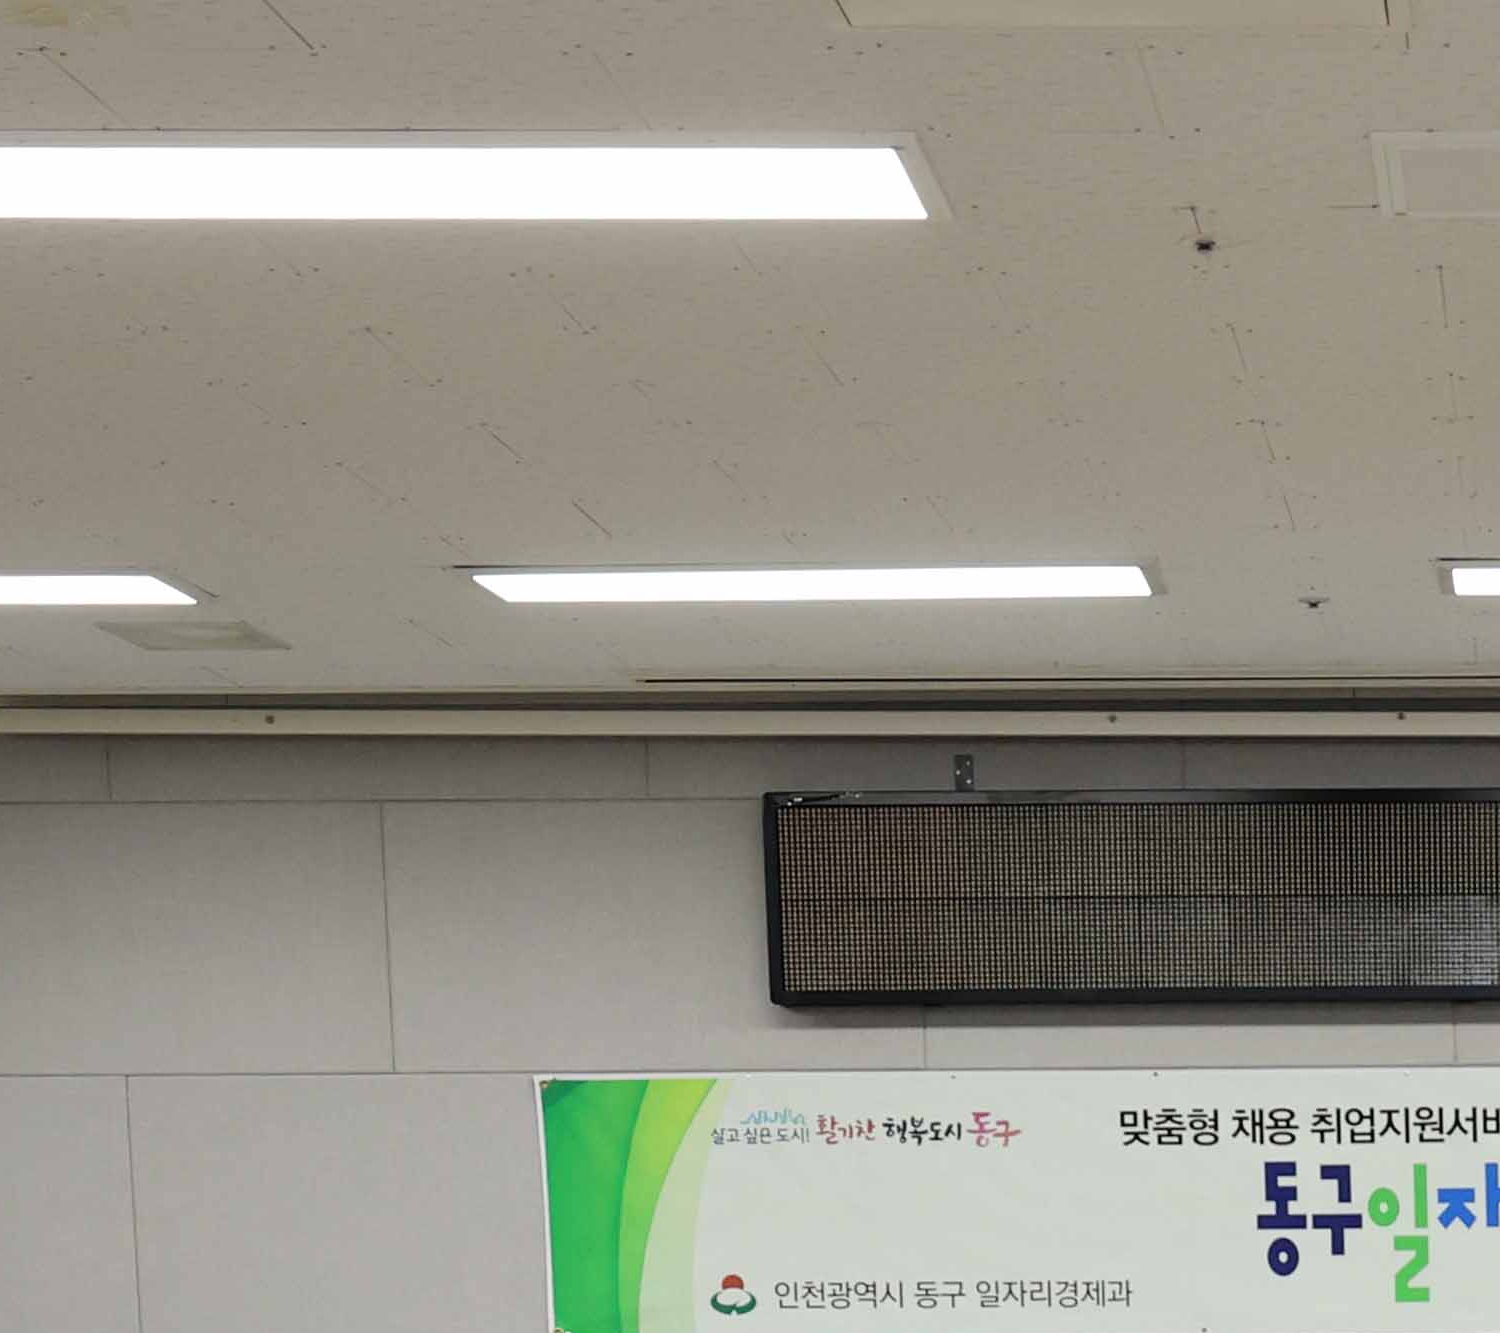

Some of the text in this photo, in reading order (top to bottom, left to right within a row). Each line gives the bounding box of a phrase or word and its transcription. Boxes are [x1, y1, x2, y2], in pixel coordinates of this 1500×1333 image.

[710, 1111, 1022, 1148] 살고 싶은 도시! 활기찬 행복도시 동구
[1118, 1108, 1220, 1146] 맞춤형
[1231, 1107, 1299, 1146] 채용
[774, 1279, 1133, 1309] 인천광역시 동구 일자리경제과
